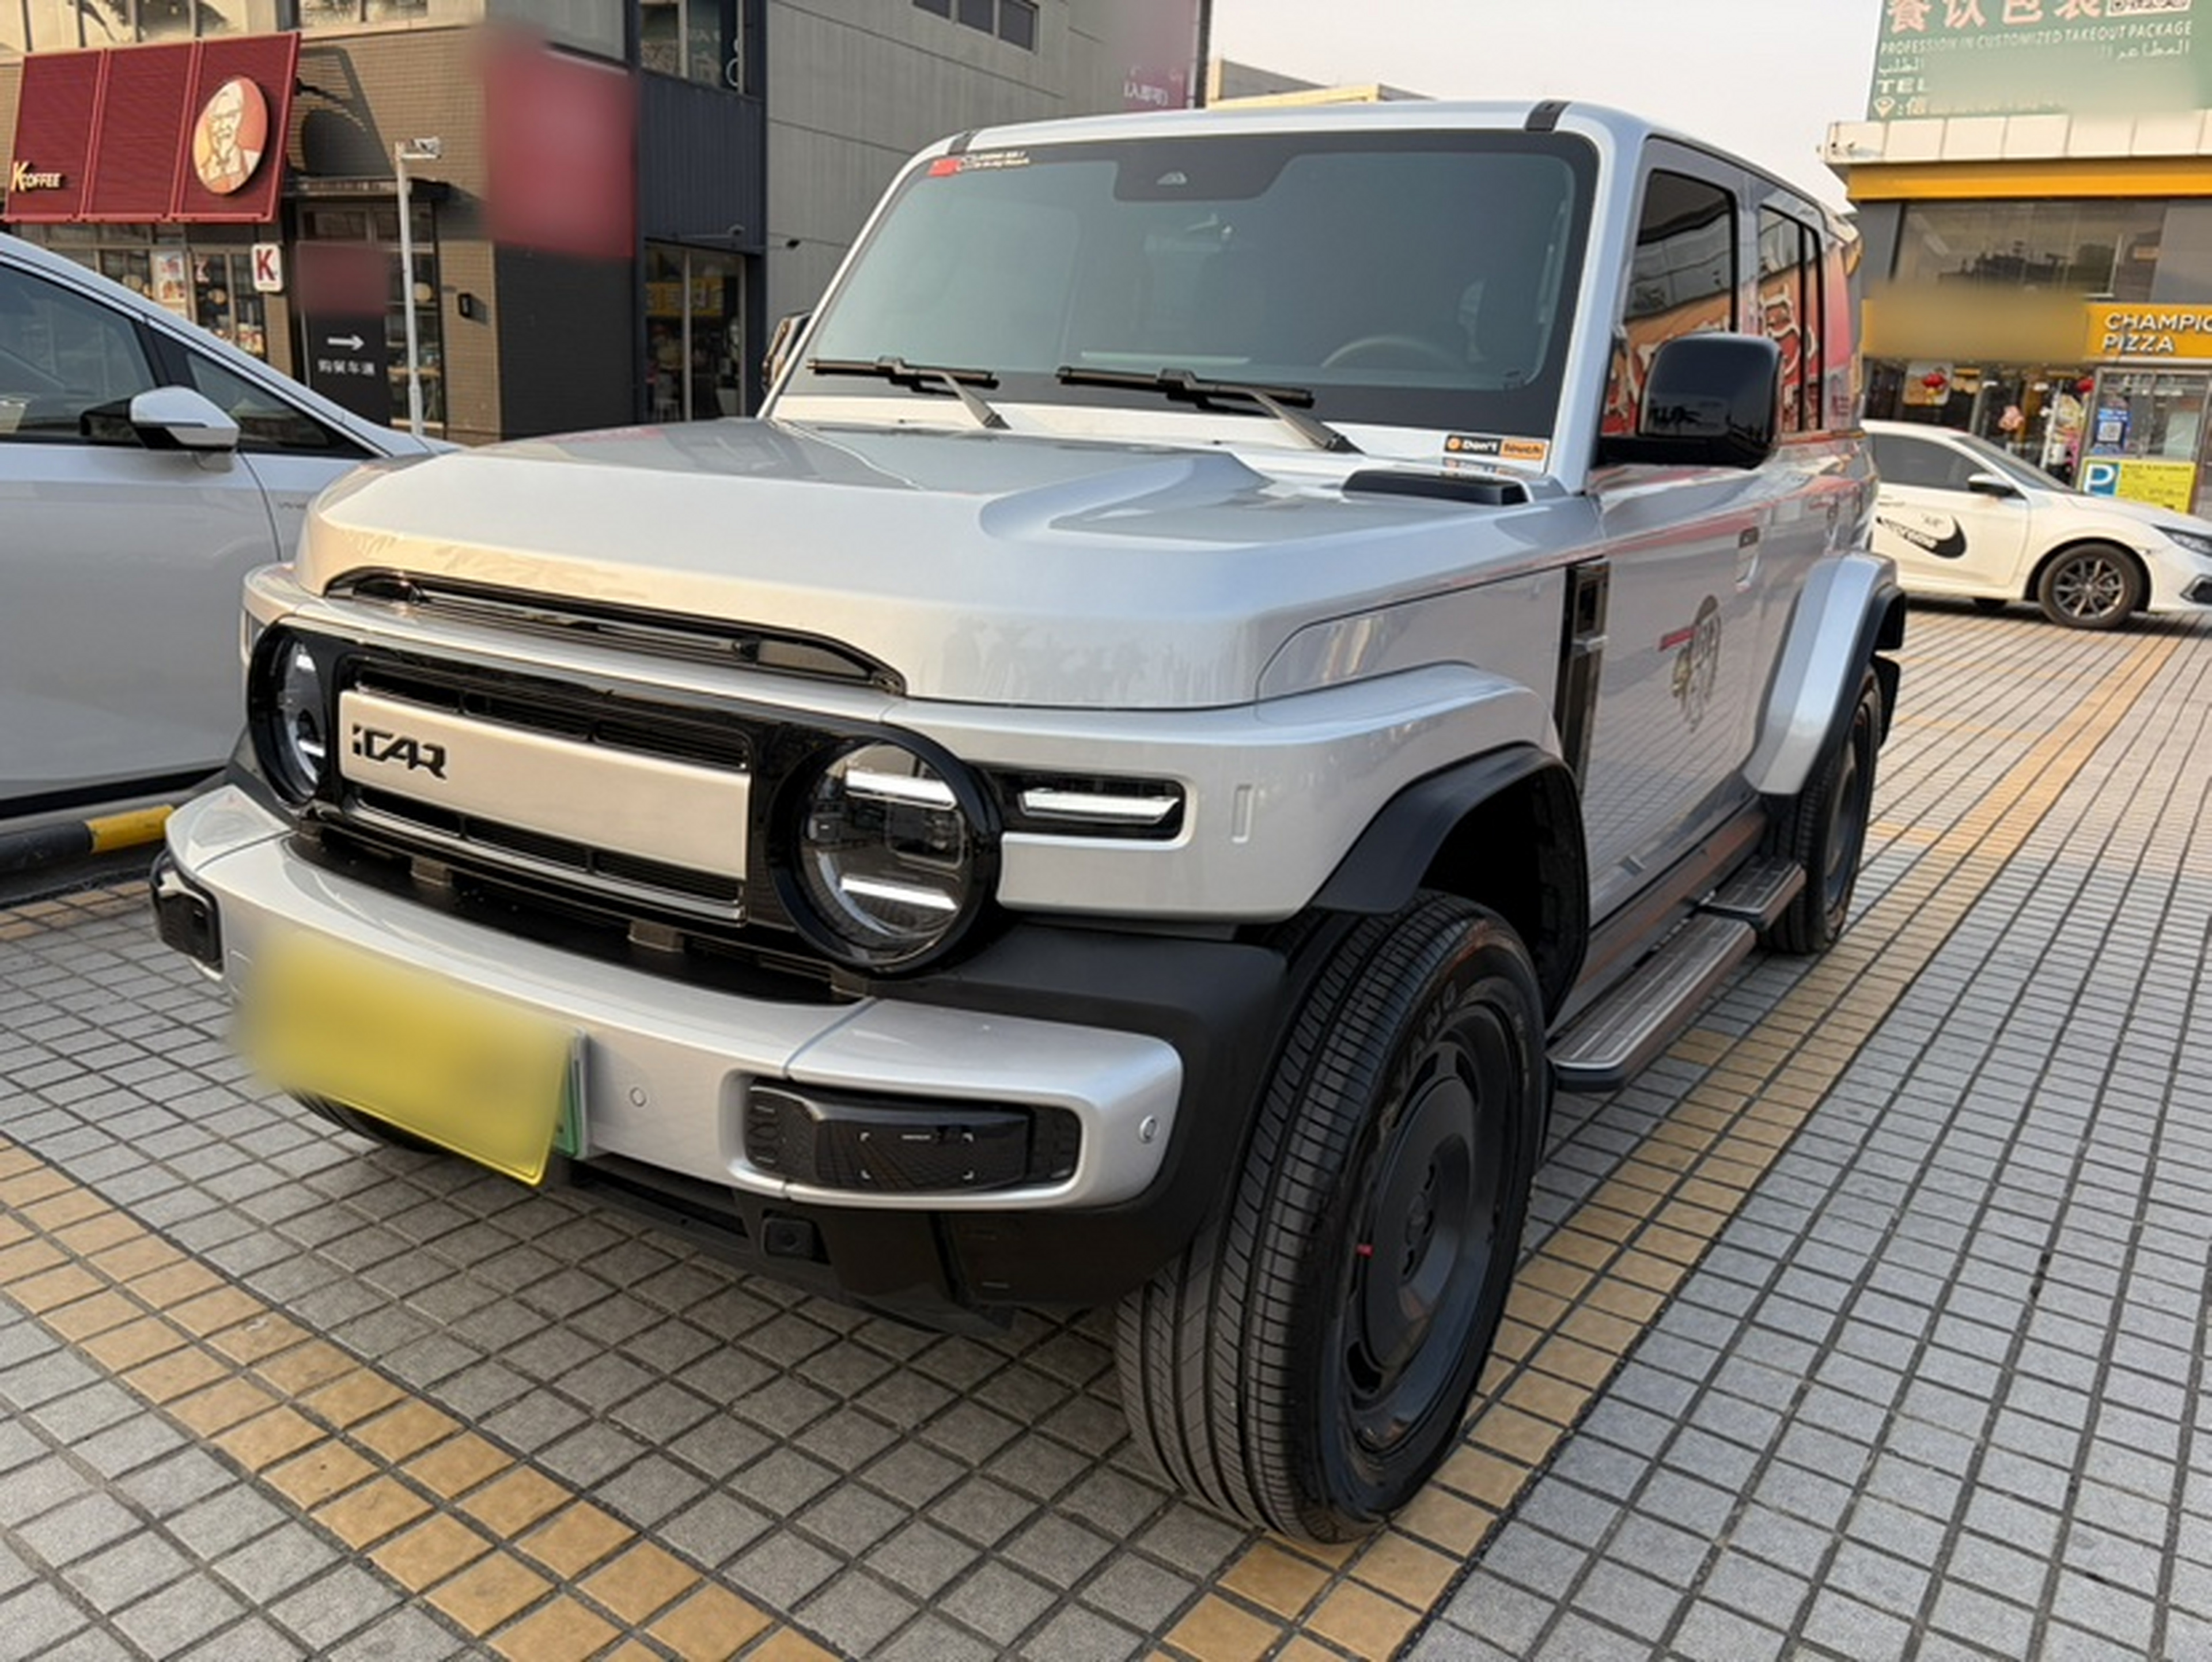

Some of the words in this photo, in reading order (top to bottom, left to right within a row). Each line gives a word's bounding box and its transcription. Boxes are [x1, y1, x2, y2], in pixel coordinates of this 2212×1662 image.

[1880, 36, 1957, 55] PROFESSION
[1977, 31, 2063, 48] CUSTOMIZED
[2063, 25, 2127, 41] TAKEOUT
[2128, 21, 2192, 38] PACKAGE
[1877, 77, 1930, 94] TEL
[255, 249, 275, 281] K
[2102, 333, 2175, 353] PIZZA
[2084, 464, 2115, 494] P
[353, 724, 445, 780] iCAR
